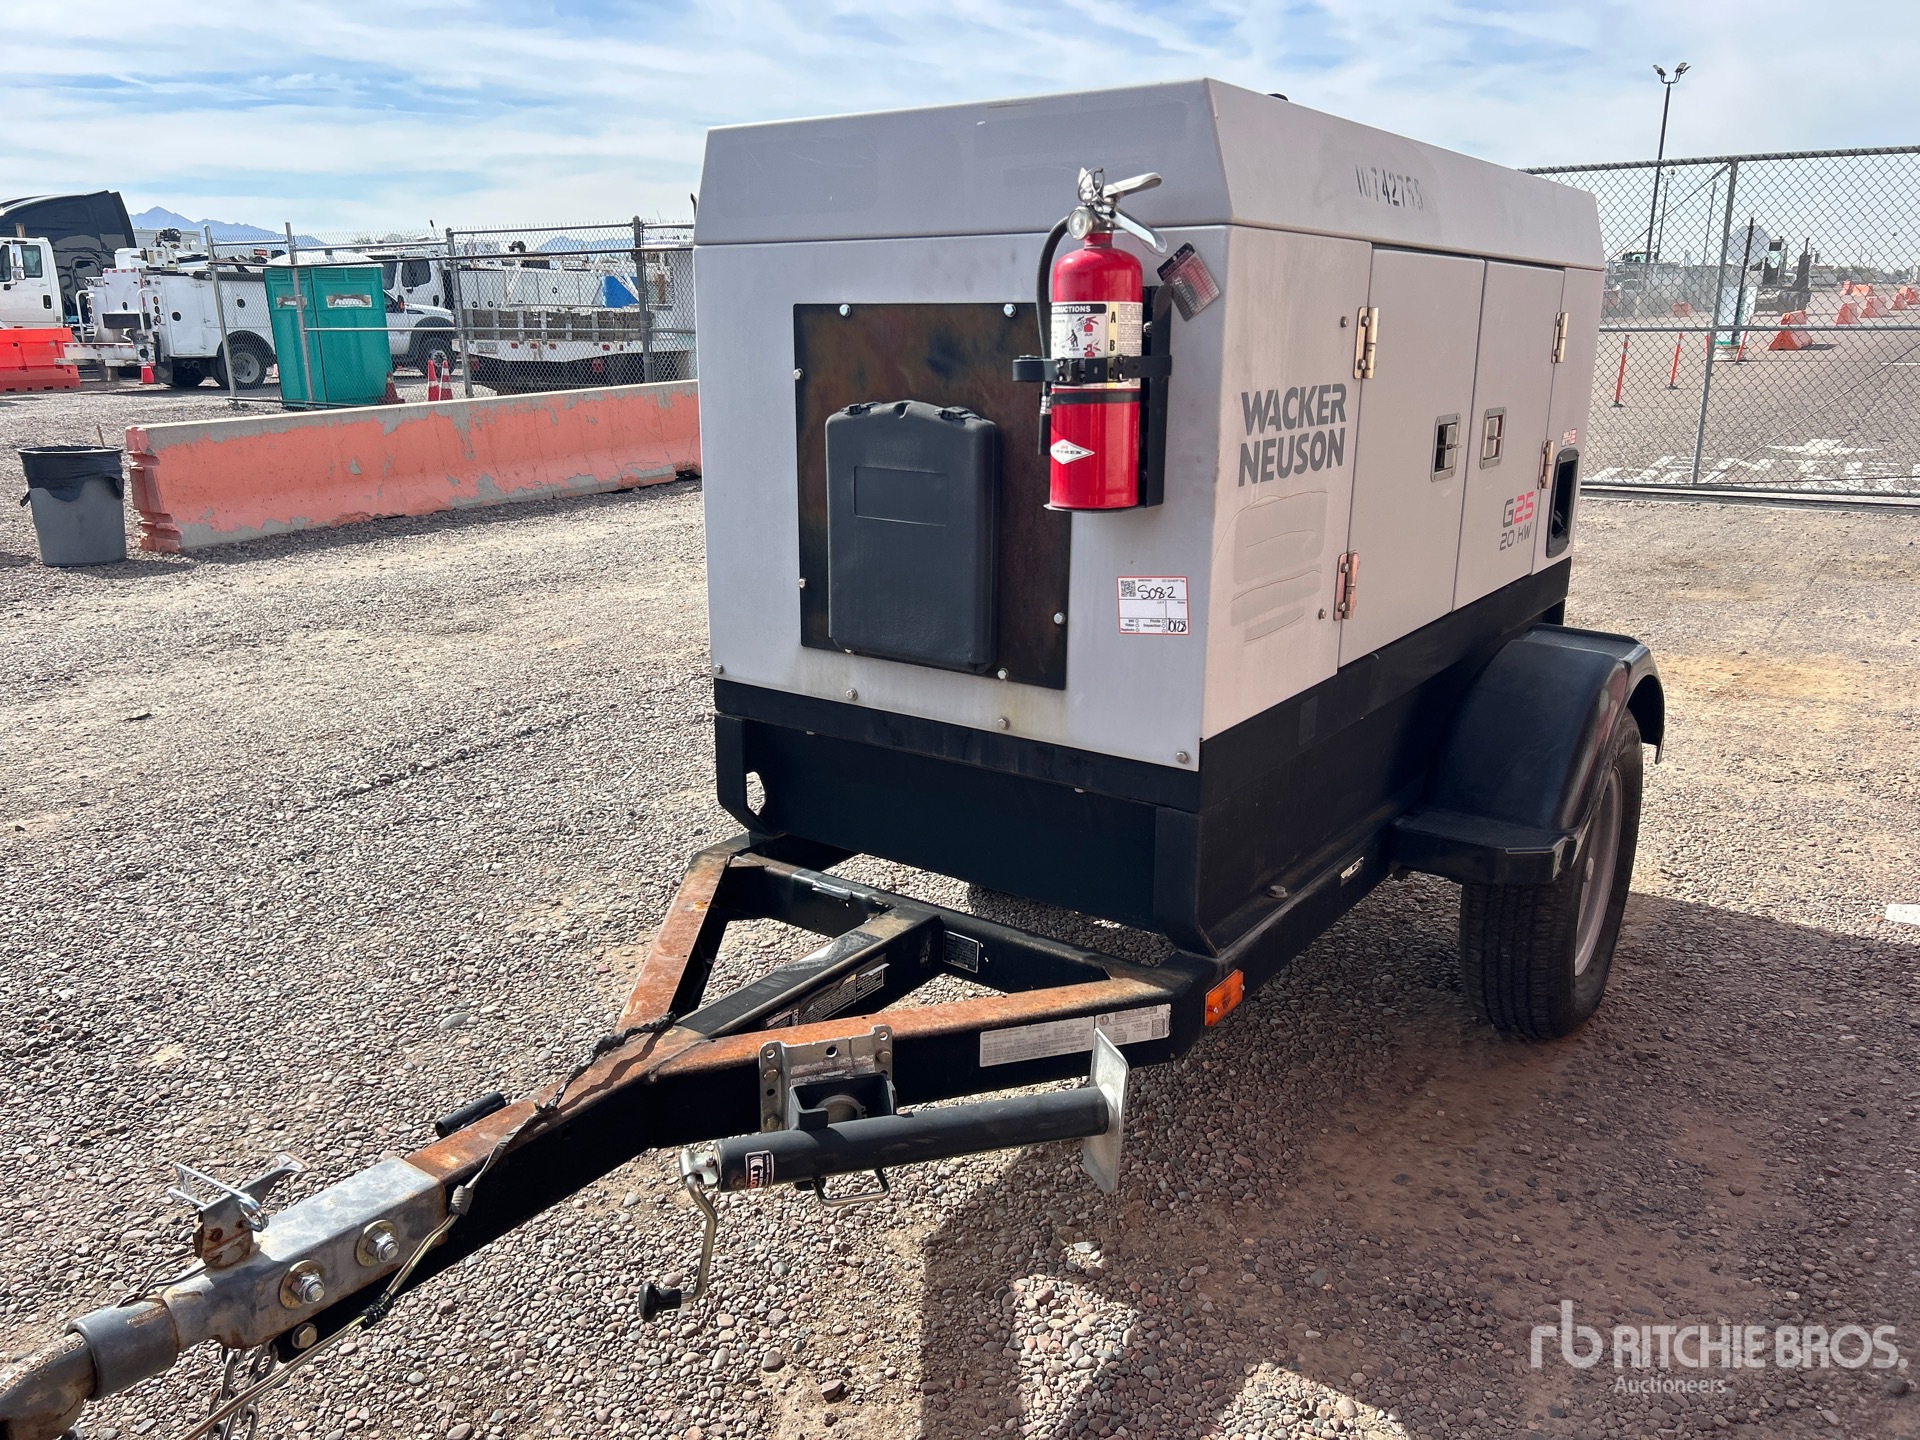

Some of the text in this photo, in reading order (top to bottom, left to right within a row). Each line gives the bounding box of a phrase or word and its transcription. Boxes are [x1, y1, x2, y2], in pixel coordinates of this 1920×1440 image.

[1110, 311, 1117, 324] A
[1109, 339, 1116, 352] B
[1241, 383, 1347, 436] WACKER
[1238, 427, 1346, 487] NEUSON
[1502, 491, 1535, 528] G25
[1499, 522, 1532, 551] 20 HW
